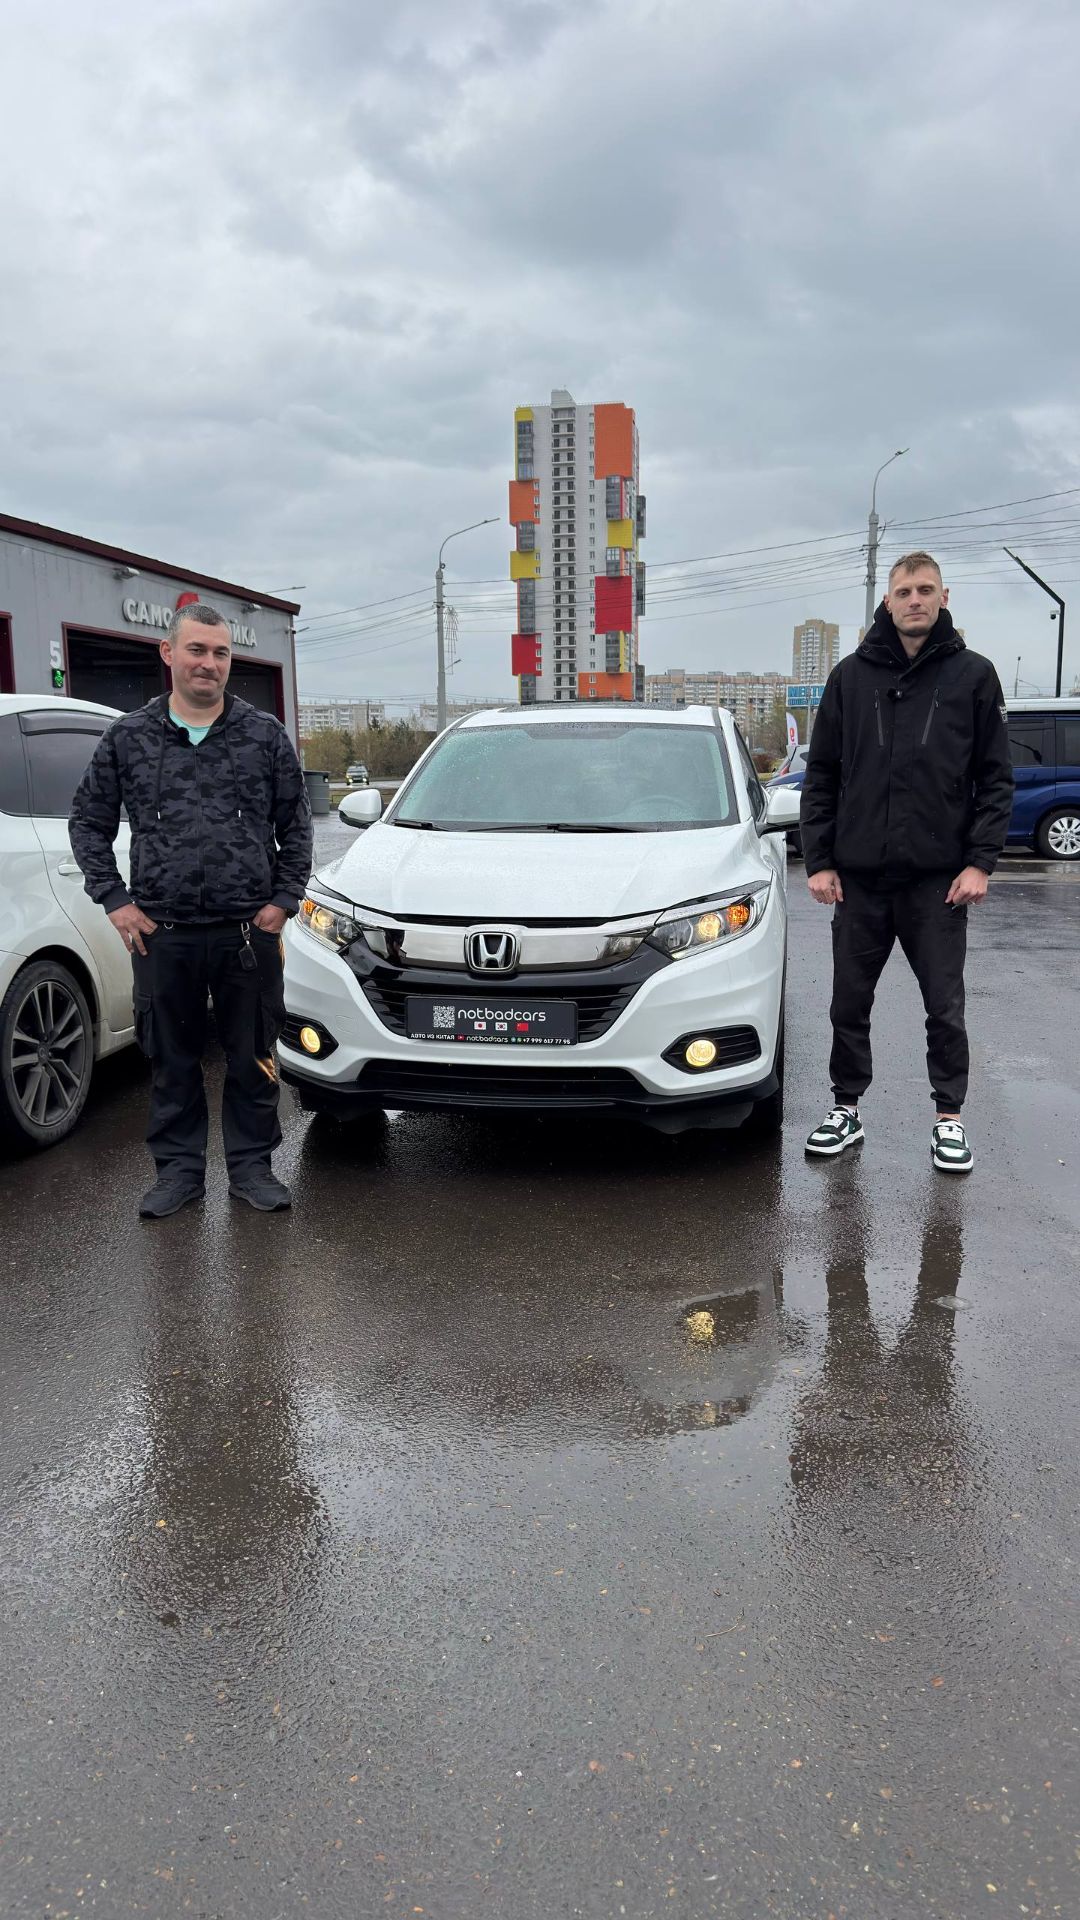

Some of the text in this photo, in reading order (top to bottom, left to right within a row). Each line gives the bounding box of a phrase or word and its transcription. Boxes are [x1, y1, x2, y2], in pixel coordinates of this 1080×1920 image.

[50, 640, 61, 669] 5
[457, 1007, 546, 1022] notbadcars
[466, 1035, 509, 1043] notbadcars
